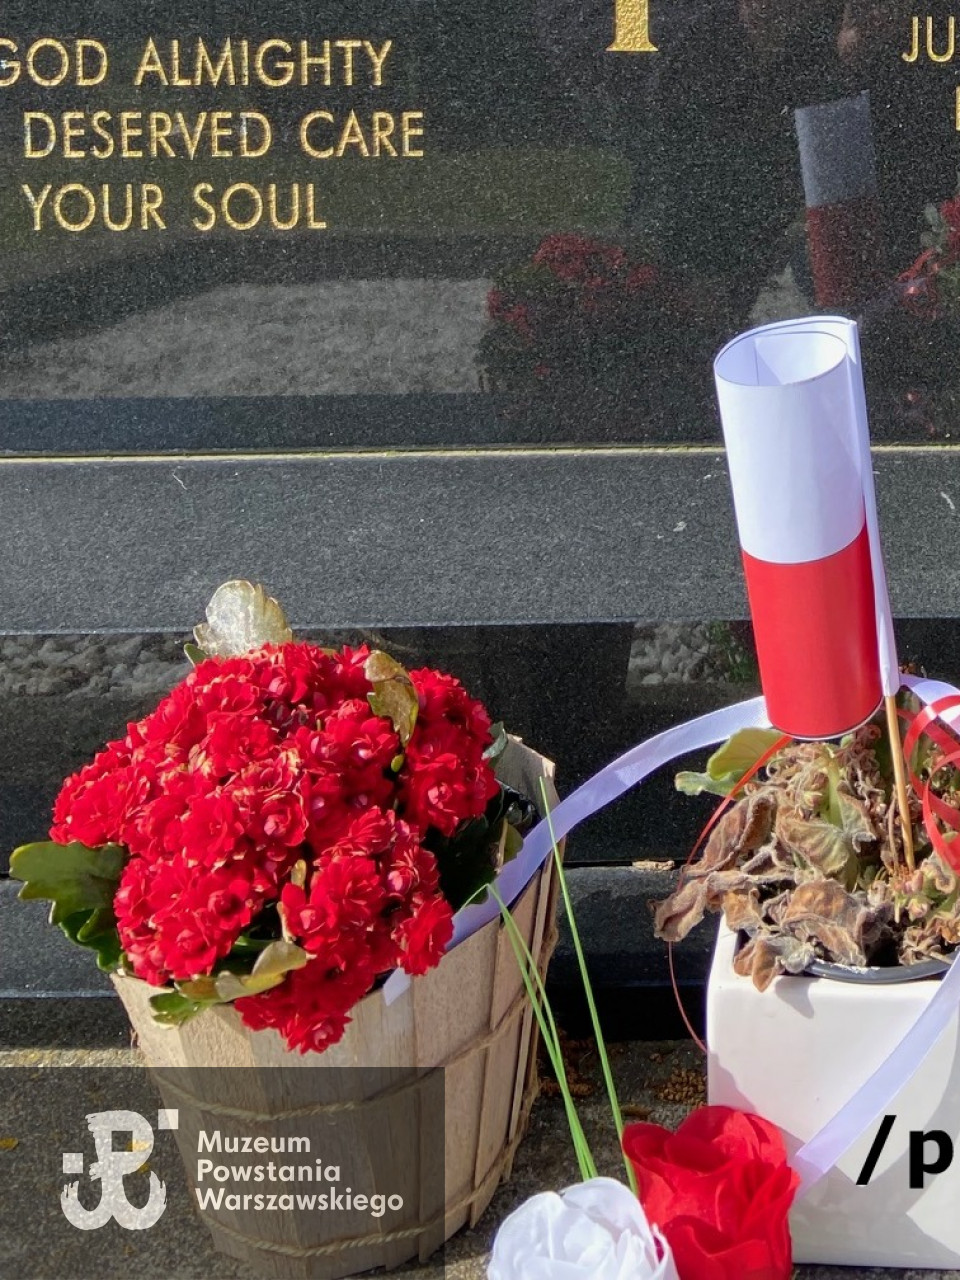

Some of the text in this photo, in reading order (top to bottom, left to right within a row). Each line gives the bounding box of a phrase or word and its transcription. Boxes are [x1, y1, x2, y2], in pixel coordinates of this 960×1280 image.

[134, 39, 392, 87] ALMIGHTY
[24, 109, 423, 159] DESERVED CARE
[23, 182, 326, 231] YOUR SOUL
